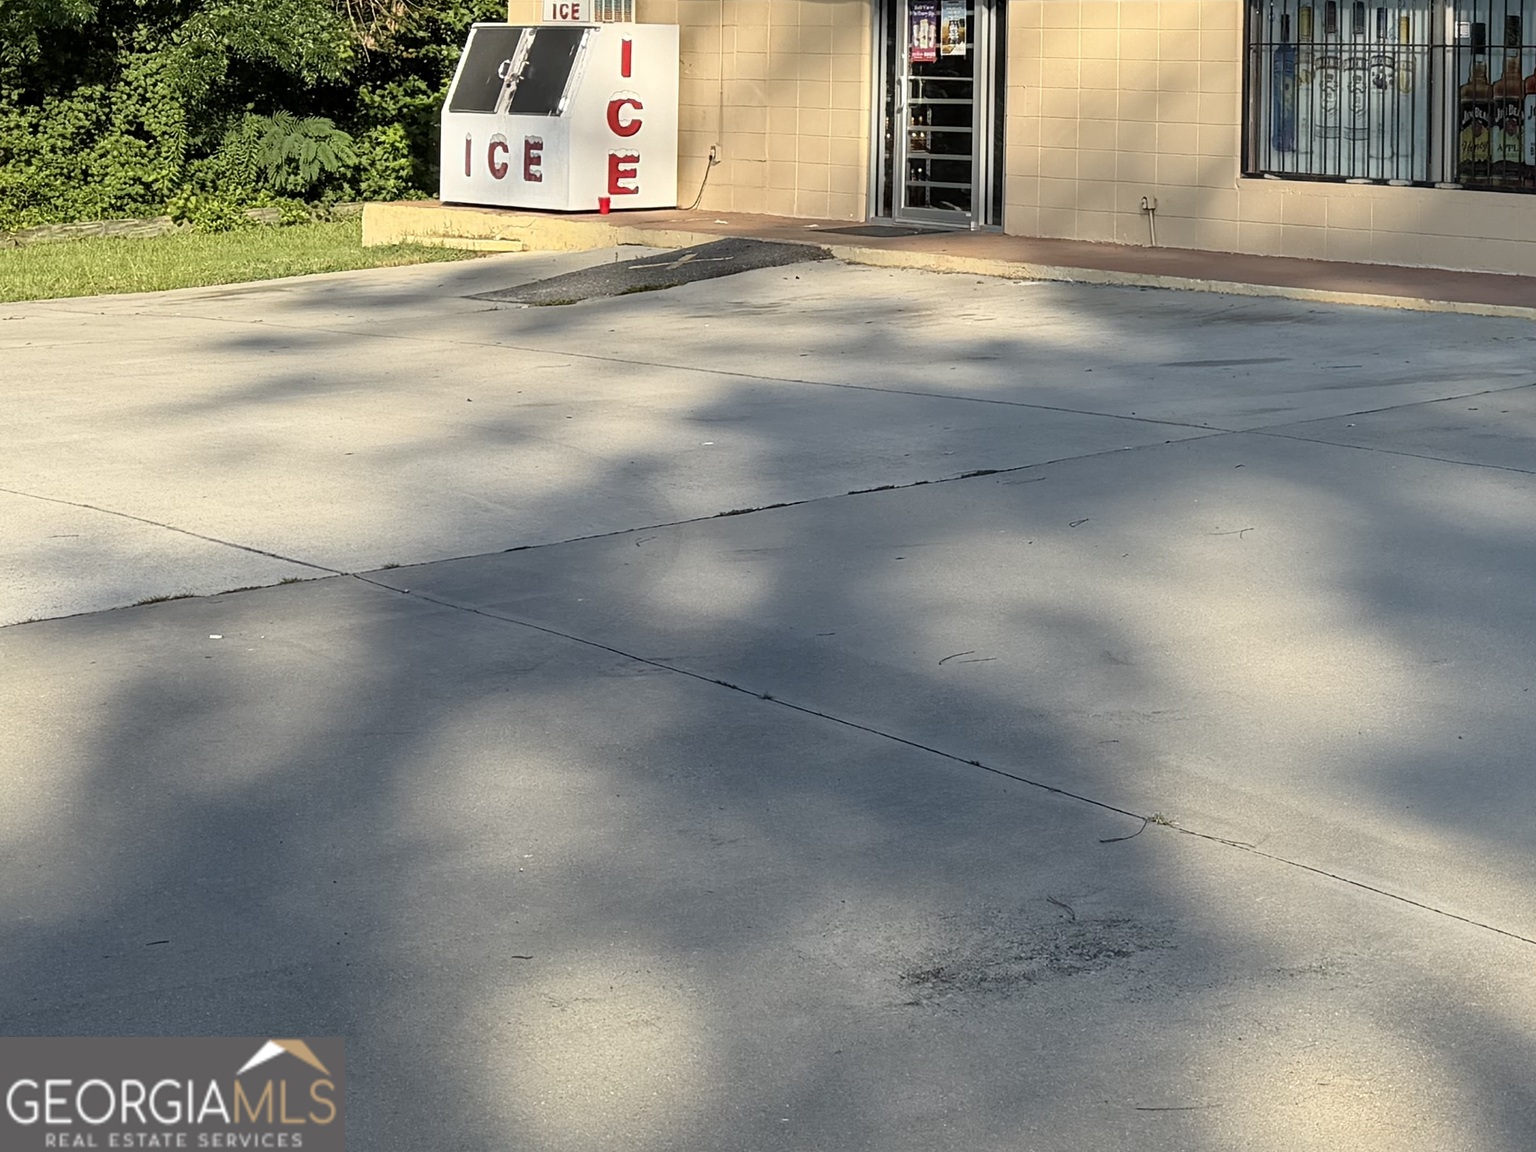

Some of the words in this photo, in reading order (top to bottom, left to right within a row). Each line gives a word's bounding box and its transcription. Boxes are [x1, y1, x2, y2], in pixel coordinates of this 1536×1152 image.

[552, 3, 580, 20] ICE
[607, 32, 644, 195] ICE
[465, 132, 544, 183] ICE
